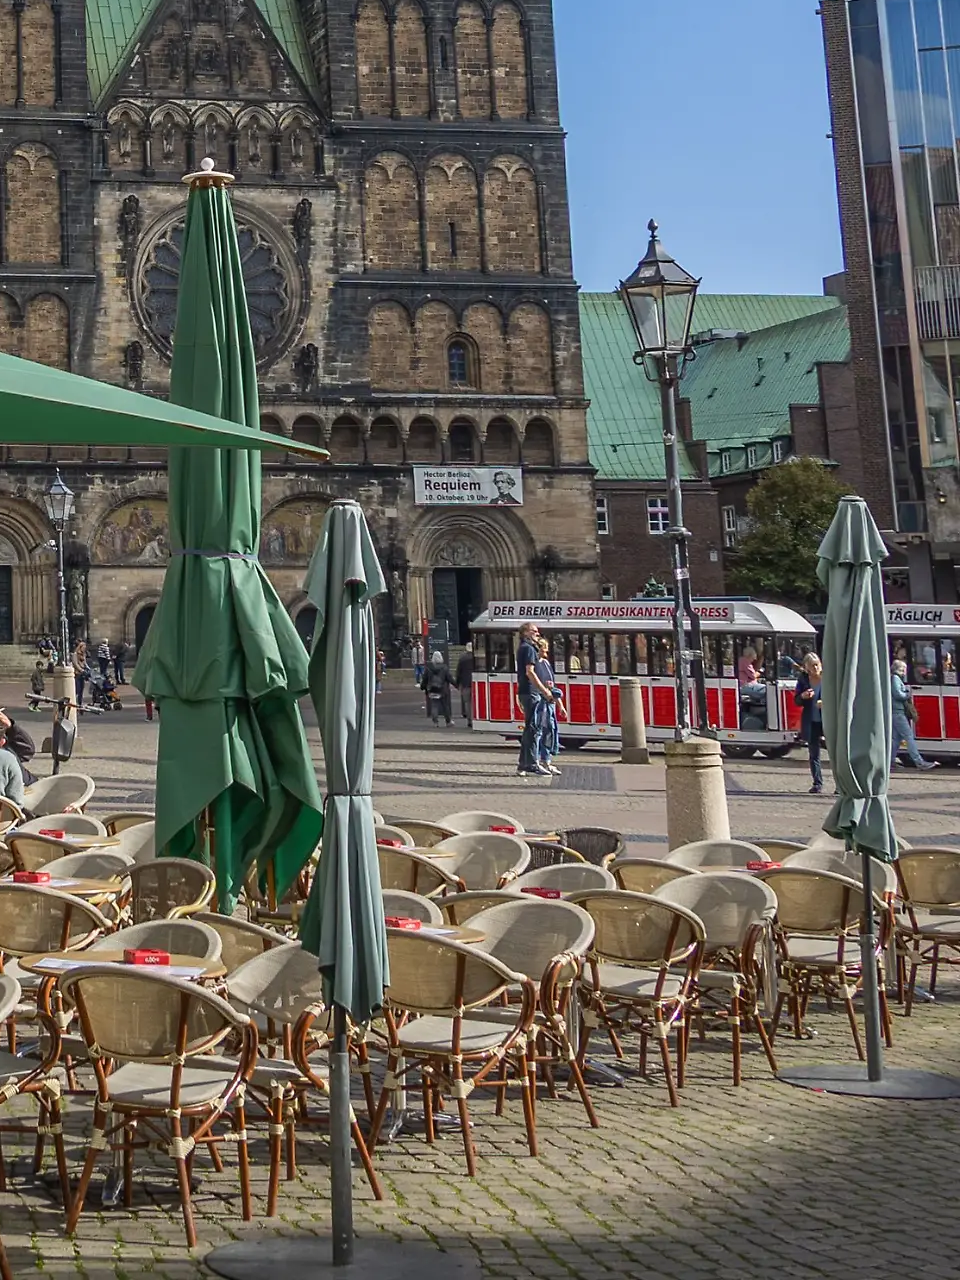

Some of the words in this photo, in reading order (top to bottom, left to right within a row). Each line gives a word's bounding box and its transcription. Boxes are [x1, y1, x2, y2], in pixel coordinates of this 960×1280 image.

[424, 479, 481, 493] Requiem
[436, 494, 465, 502] Oktober,
[493, 606, 515, 616] DER
[519, 606, 563, 616] BREMER
[888, 608, 943, 622] TÄGLICH
